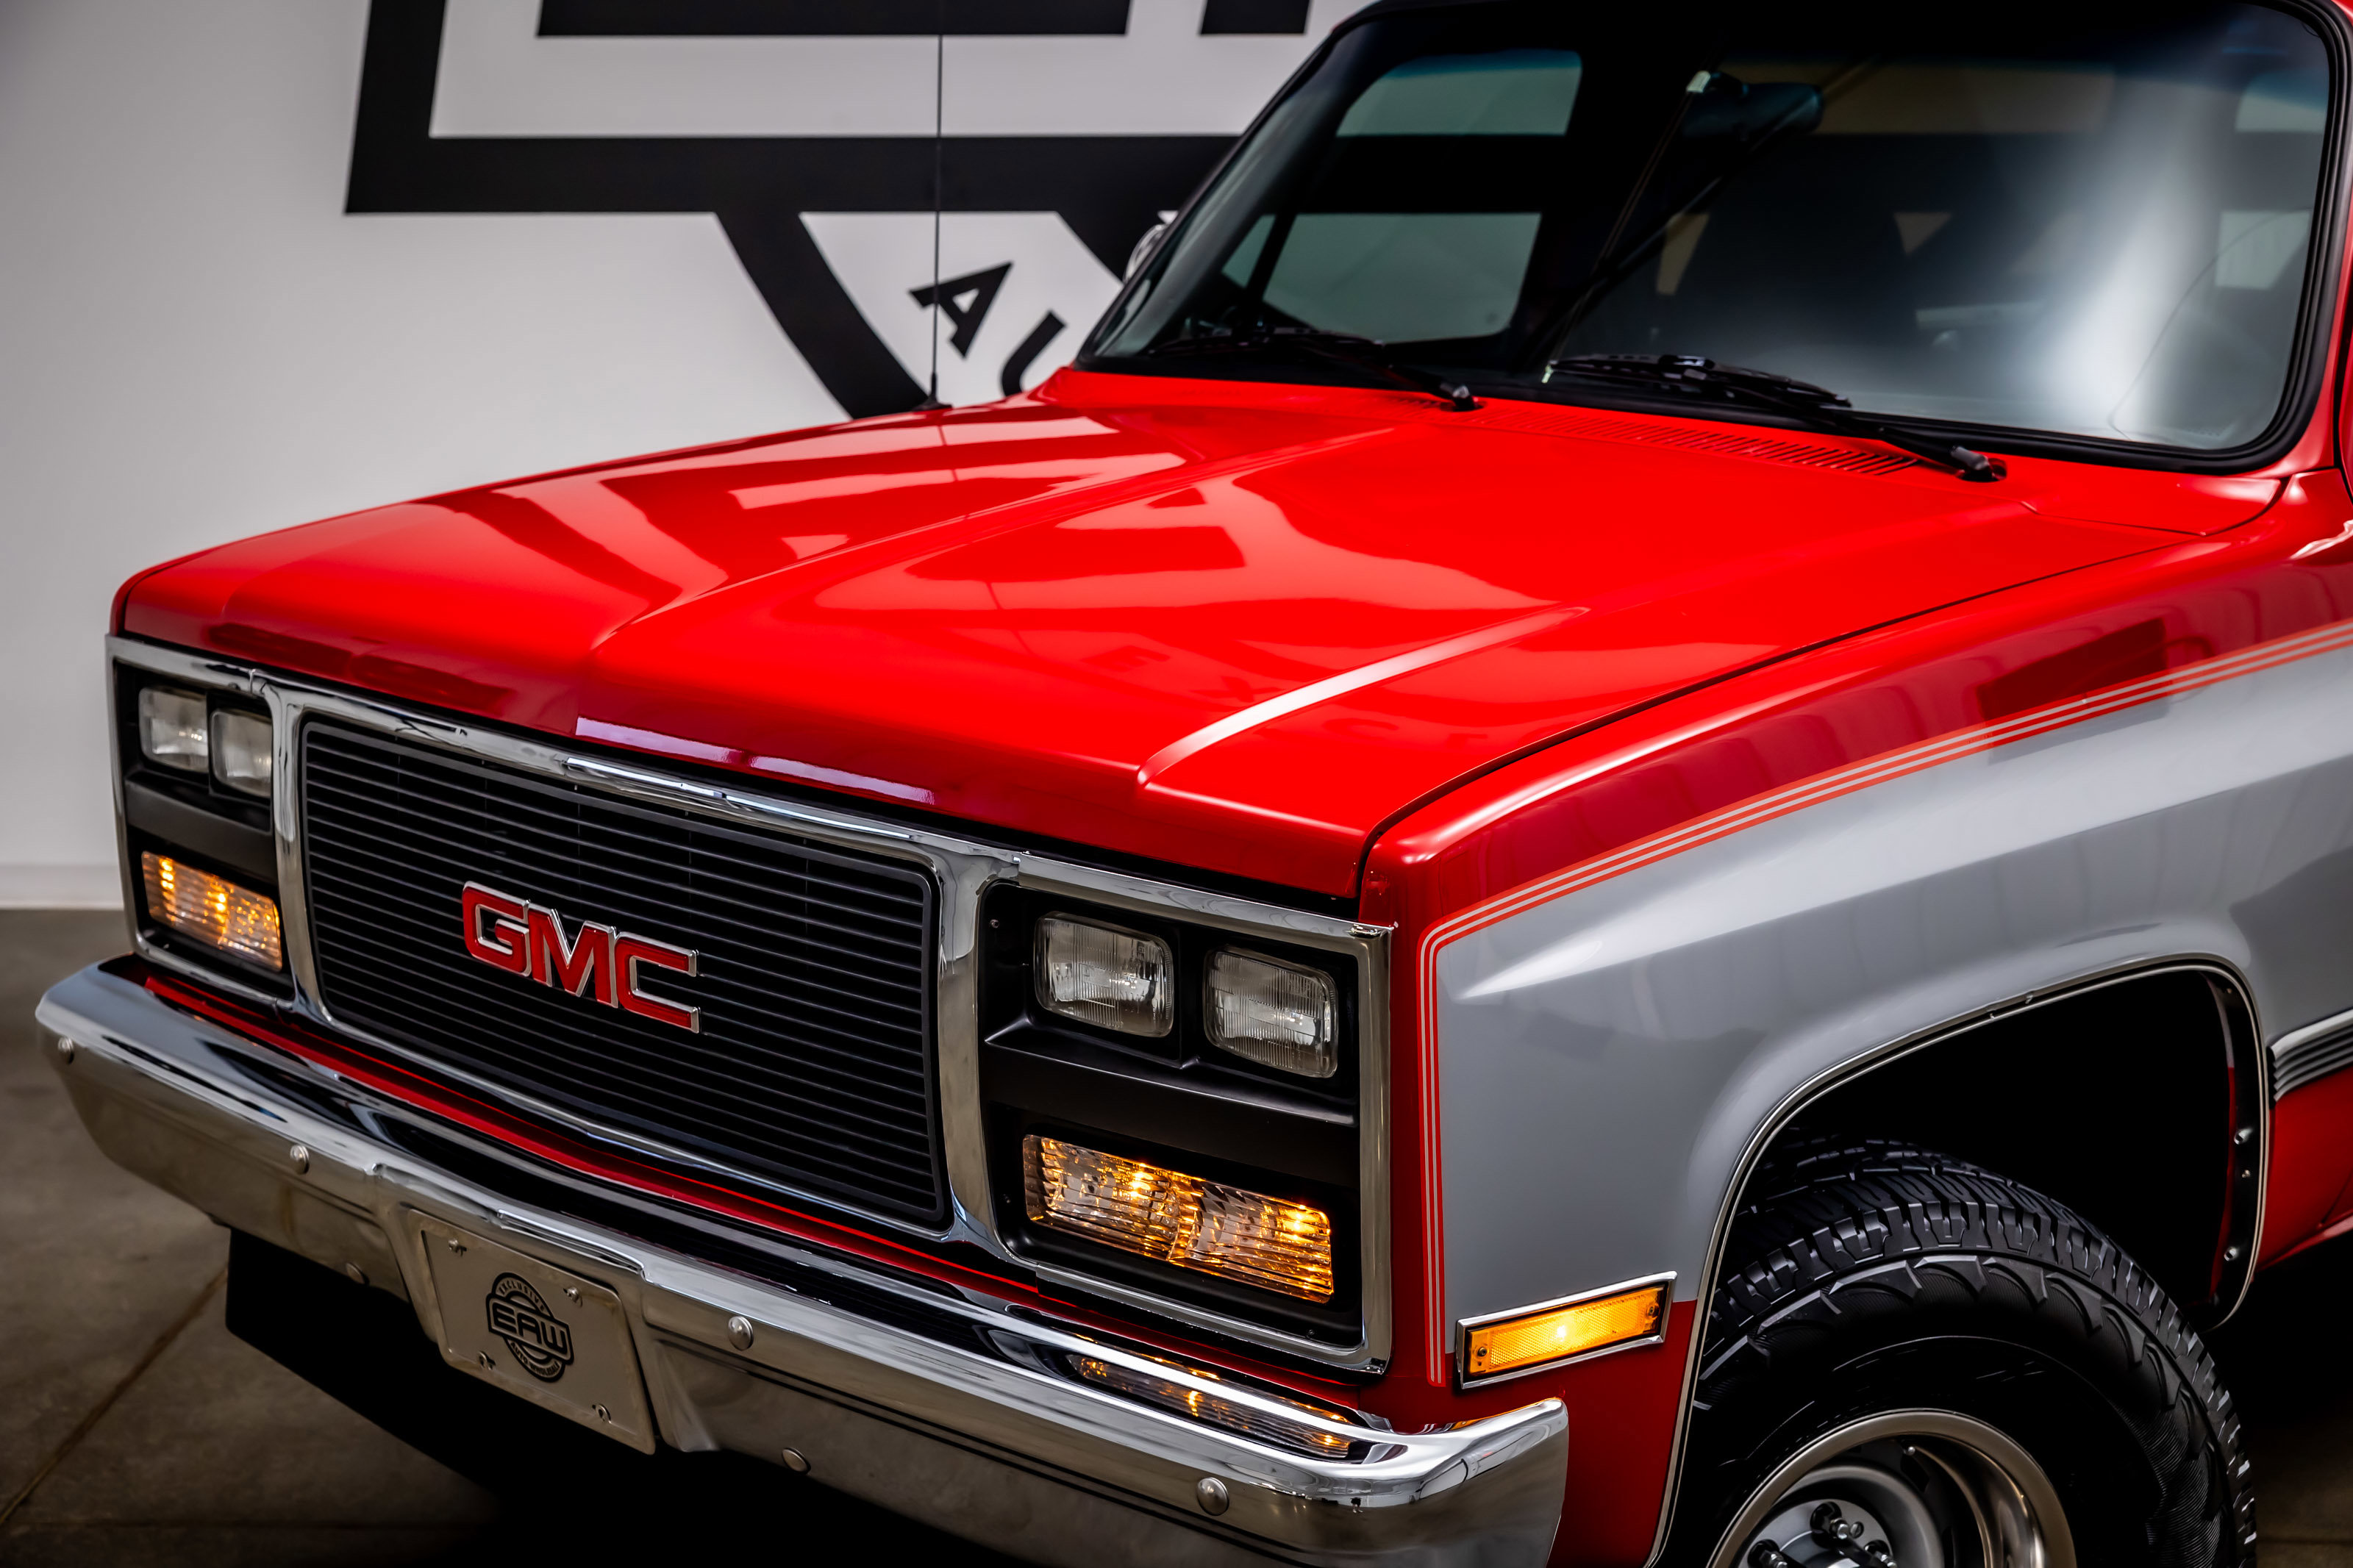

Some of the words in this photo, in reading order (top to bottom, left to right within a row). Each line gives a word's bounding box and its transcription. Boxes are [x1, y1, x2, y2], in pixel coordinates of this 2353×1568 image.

[462, 881, 700, 1034] GMC
[499, 1280, 545, 1311] EXCLUSIVE
[492, 1302, 568, 1355] EAW
[510, 1342, 528, 1364] AUTO
[529, 1361, 560, 1377] WHOLESALE
